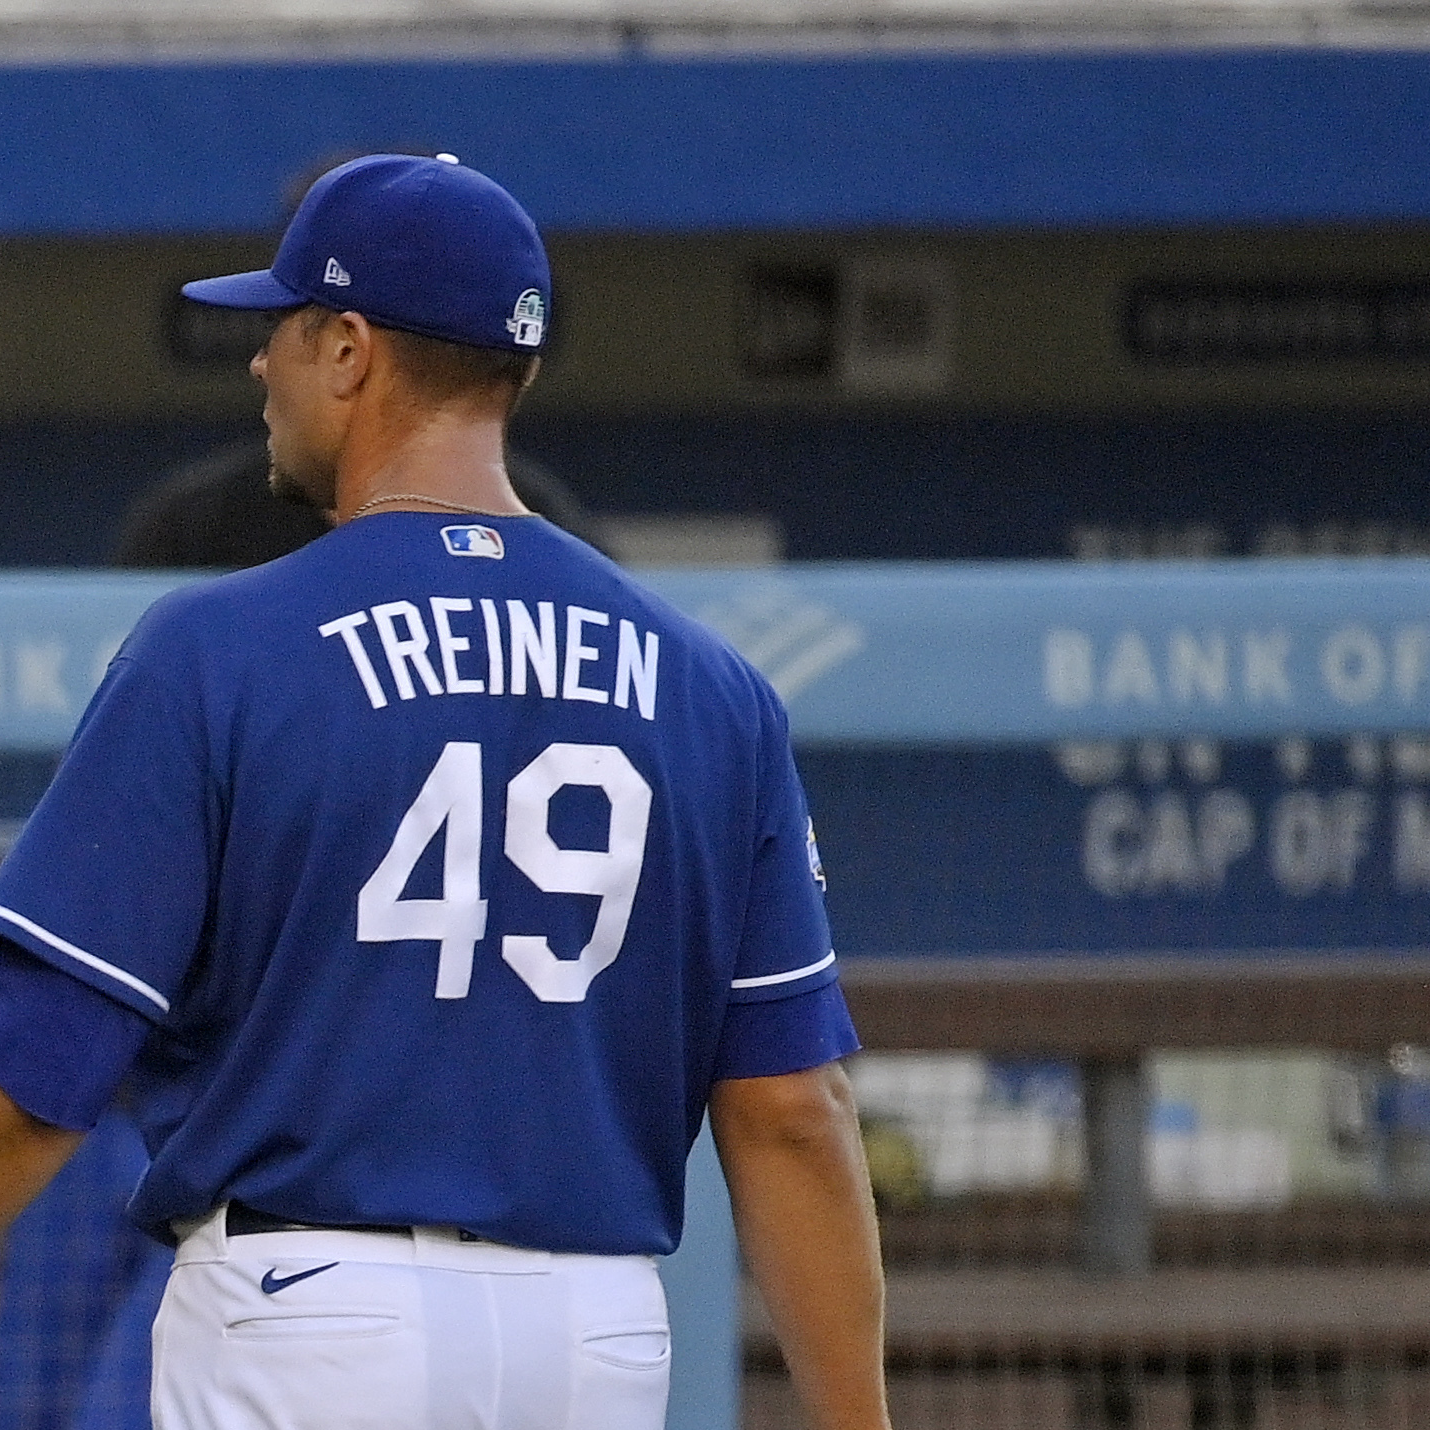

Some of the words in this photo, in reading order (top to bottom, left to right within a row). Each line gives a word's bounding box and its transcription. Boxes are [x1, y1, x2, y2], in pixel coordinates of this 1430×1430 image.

[318, 597, 660, 721] TREINEN
[1044, 626, 1291, 710] BANK
[356, 741, 653, 1003] 49
[1083, 786, 1259, 898] CAP
[1267, 788, 1373, 898] OF
